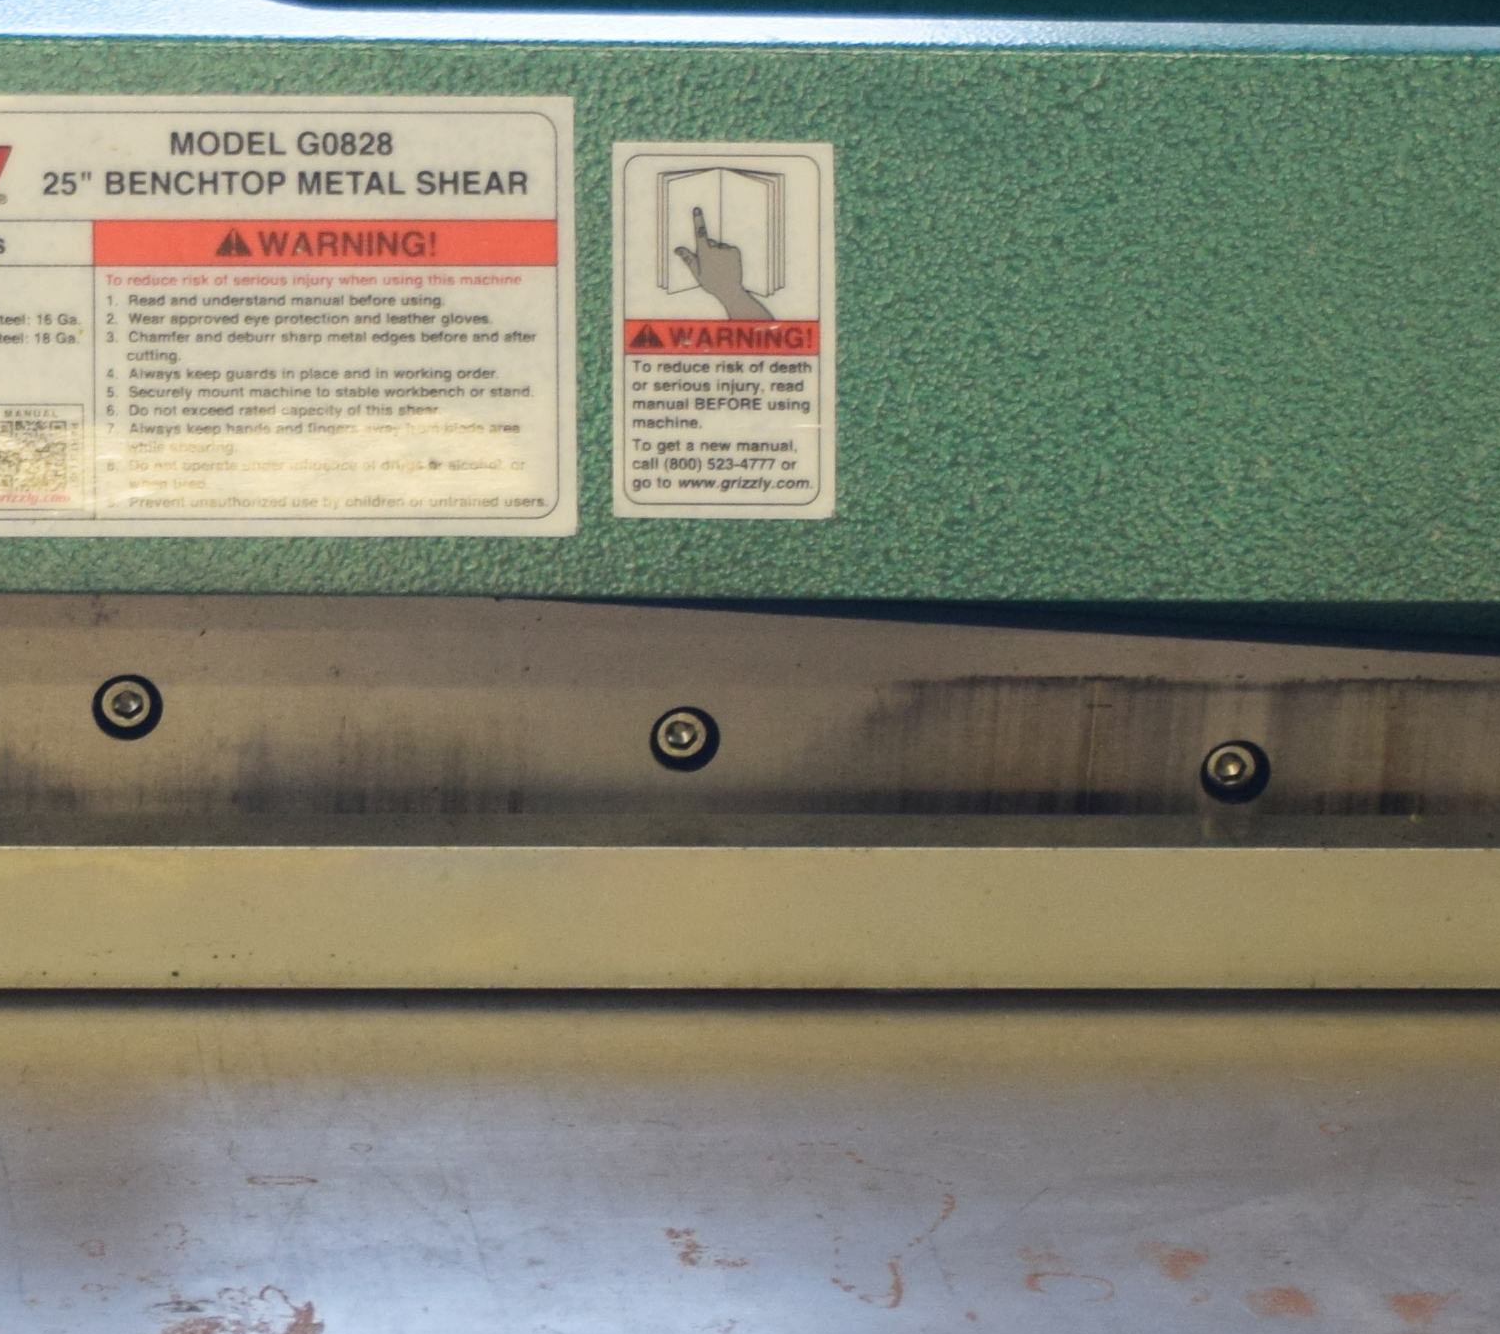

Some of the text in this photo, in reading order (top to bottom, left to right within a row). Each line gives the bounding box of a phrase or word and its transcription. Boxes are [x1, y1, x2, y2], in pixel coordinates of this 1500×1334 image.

[170, 131, 394, 157] MODEL G0828
[42, 170, 528, 196] 25" BENCHTOP METAL SHEAR
[258, 230, 436, 257] WARNING!
[106, 273, 522, 289] To reduce risk of serious injury when using this machine
[128, 294, 166, 307] Read
[170, 295, 198, 307] and
[202, 295, 286, 307] understand
[291, 295, 344, 307] manual
[348, 294, 396, 307] before
[37, 313, 52, 325] 16
[128, 312, 165, 325] Wear
[170, 313, 240, 327] approved
[244, 314, 270, 327] eye
[274, 313, 350, 327] protection
[354, 313, 382, 325] and
[386, 312, 436, 325] leather
[34, 331, 51, 344] 18
[128, 329, 537, 346] Chamfer and deburr sharp metal edges before and after
[669, 327, 812, 349] WARNING!
[632, 359, 812, 374] To reduce risk of death
[128, 367, 182, 383] Always
[186, 368, 222, 382] keep
[226, 368, 277, 383] guards
[282, 368, 295, 379] in
[299, 368, 340, 382] place
[343, 367, 371, 379] and
[375, 367, 389, 379] in
[393, 367, 452, 383] working
[128, 385, 192, 401] Securely
[197, 386, 244, 398] mount
[249, 386, 312, 398] machine
[316, 386, 331, 398] to
[334, 386, 380, 398] stable
[384, 385, 465, 398] workbench
[469, 387, 486, 398] or
[632, 381, 648, 391] or
[653, 379, 711, 392] serious
[770, 379, 804, 393] read
[128, 403, 149, 417] Do
[154, 405, 178, 417] not
[181, 404, 234, 417] exceed
[238, 403, 276, 416] rated
[347, 403, 362, 416] of
[364, 403, 394, 416] this
[398, 403, 440, 417] shear
[632, 397, 811, 415] manual BEFORE using
[632, 438, 652, 452] To
[656, 439, 681, 455] get
[686, 441, 695, 452] a
[700, 441, 732, 452] new
[632, 457, 797, 473] call (800) 523-4777 or
[632, 478, 652, 492] go
[656, 477, 672, 489] to
